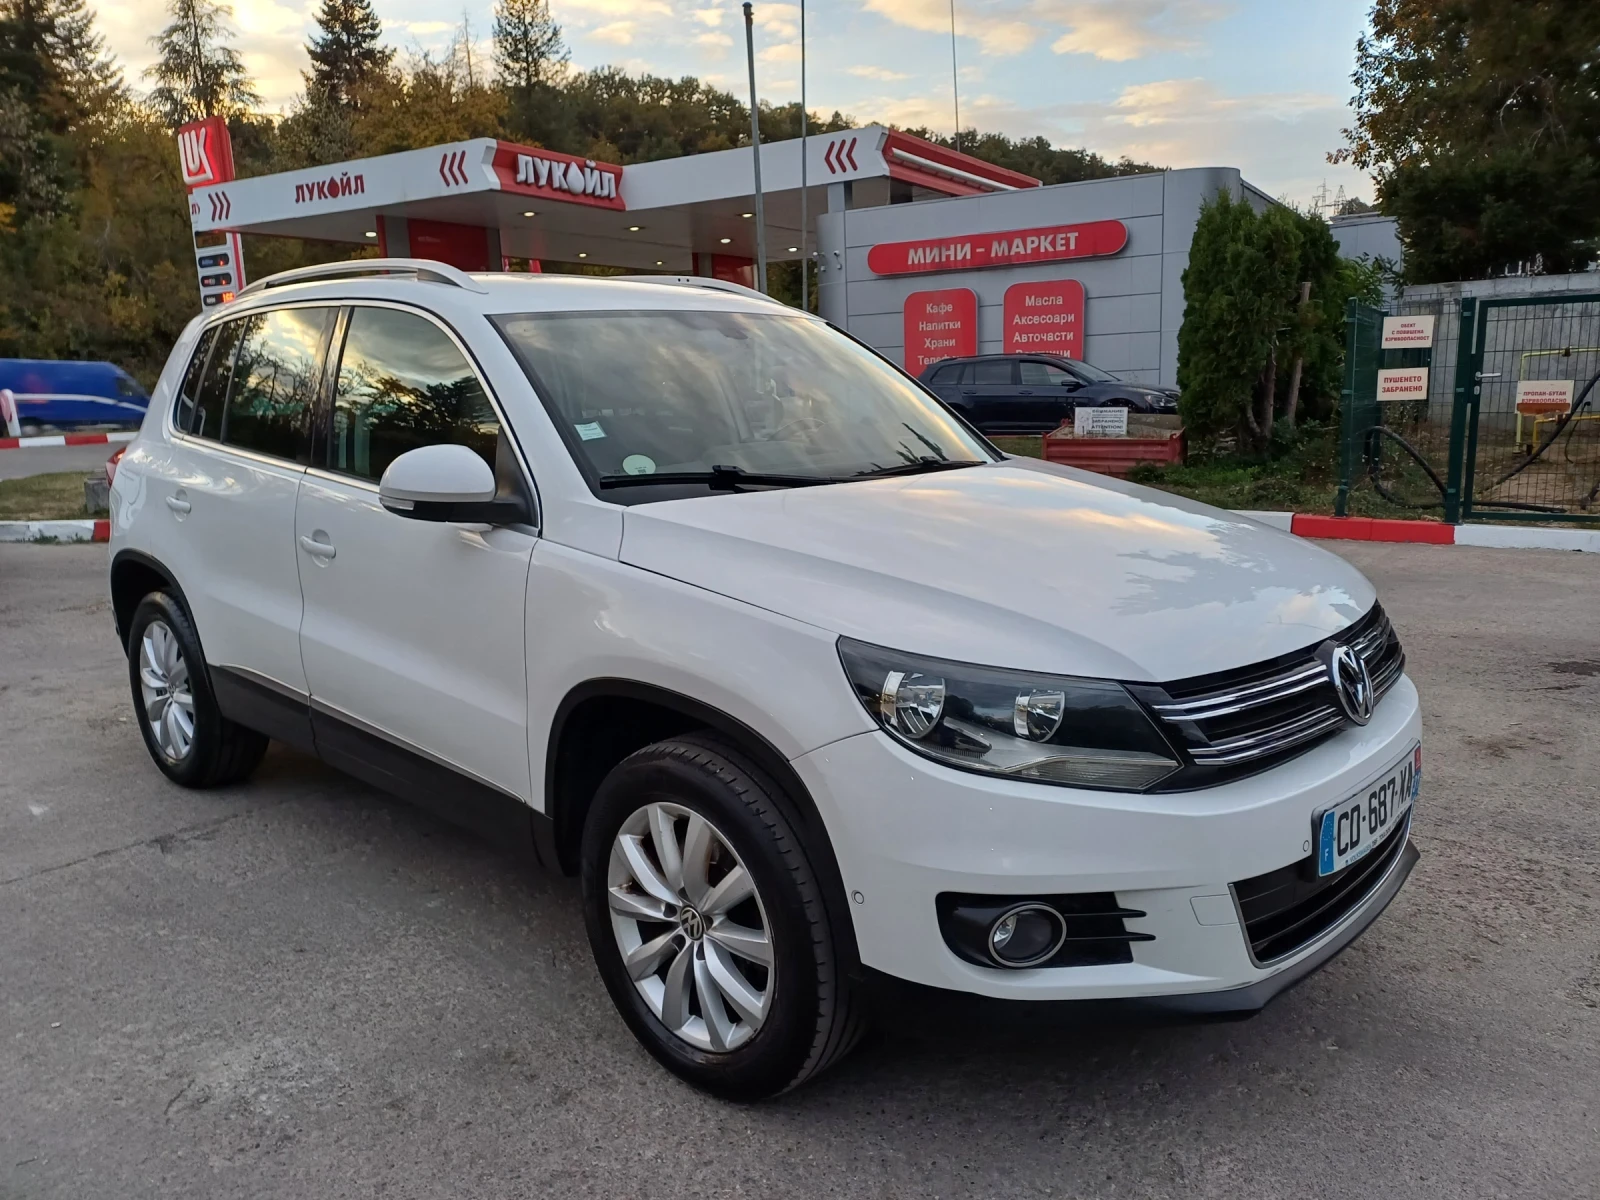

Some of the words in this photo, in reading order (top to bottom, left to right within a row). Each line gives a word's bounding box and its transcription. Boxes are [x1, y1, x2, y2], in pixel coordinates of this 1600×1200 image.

[516, 153, 616, 200] ЛУКОЙЛ
[295, 172, 365, 203] ЛУКОЙЛ
[907, 242, 971, 265] МИНИ
[990, 232, 1079, 258] МАРКЕТ
[1025, 295, 1063, 307] Масла
[926, 302, 954, 315] Кафе
[1013, 312, 1075, 326] Аксесоари
[918, 320, 961, 332] Напитки
[924, 338, 956, 350] Храни
[1013, 331, 1074, 344] Авточасти
[1383, 375, 1422, 384] ПУШЕНЕТО
[1382, 385, 1423, 393] ЗАБРАНЕНО
